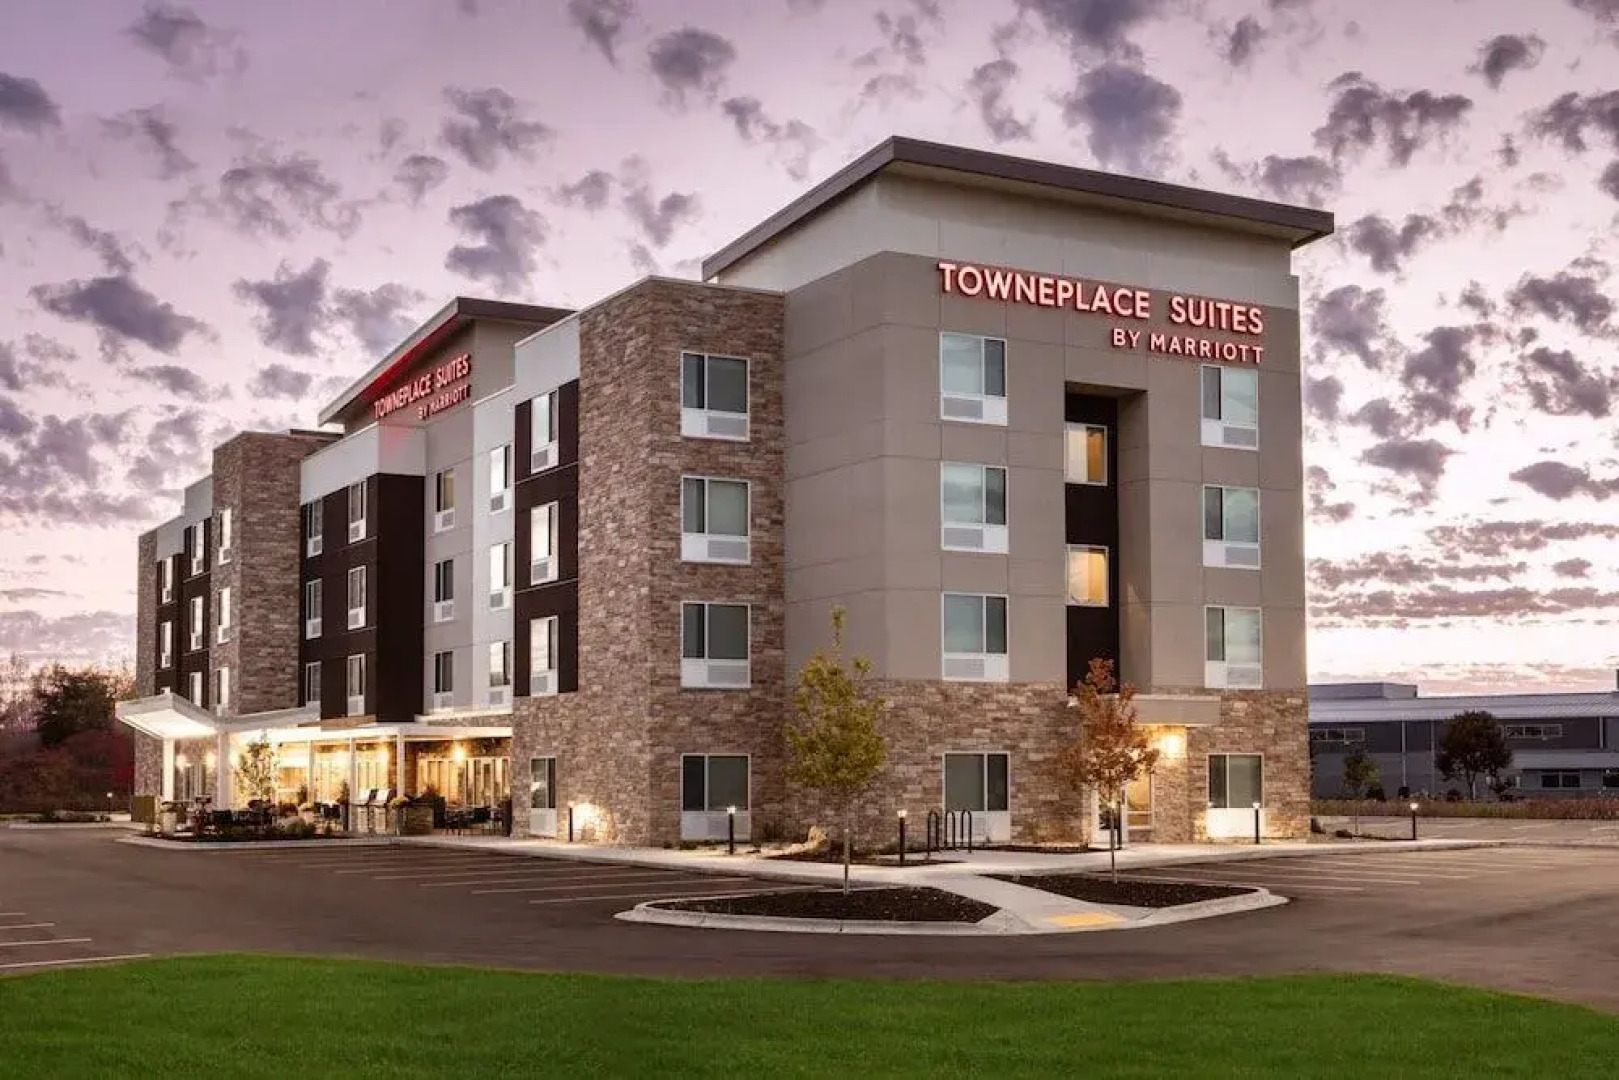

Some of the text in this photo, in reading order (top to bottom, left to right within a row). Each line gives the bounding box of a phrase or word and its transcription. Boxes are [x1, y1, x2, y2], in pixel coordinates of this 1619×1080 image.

[938, 262, 1264, 334] TOWNEPLACE SUITES
[1112, 328, 1264, 363] BY MARRIOTT
[374, 353, 470, 419] TOWNEPLACE SUITES
